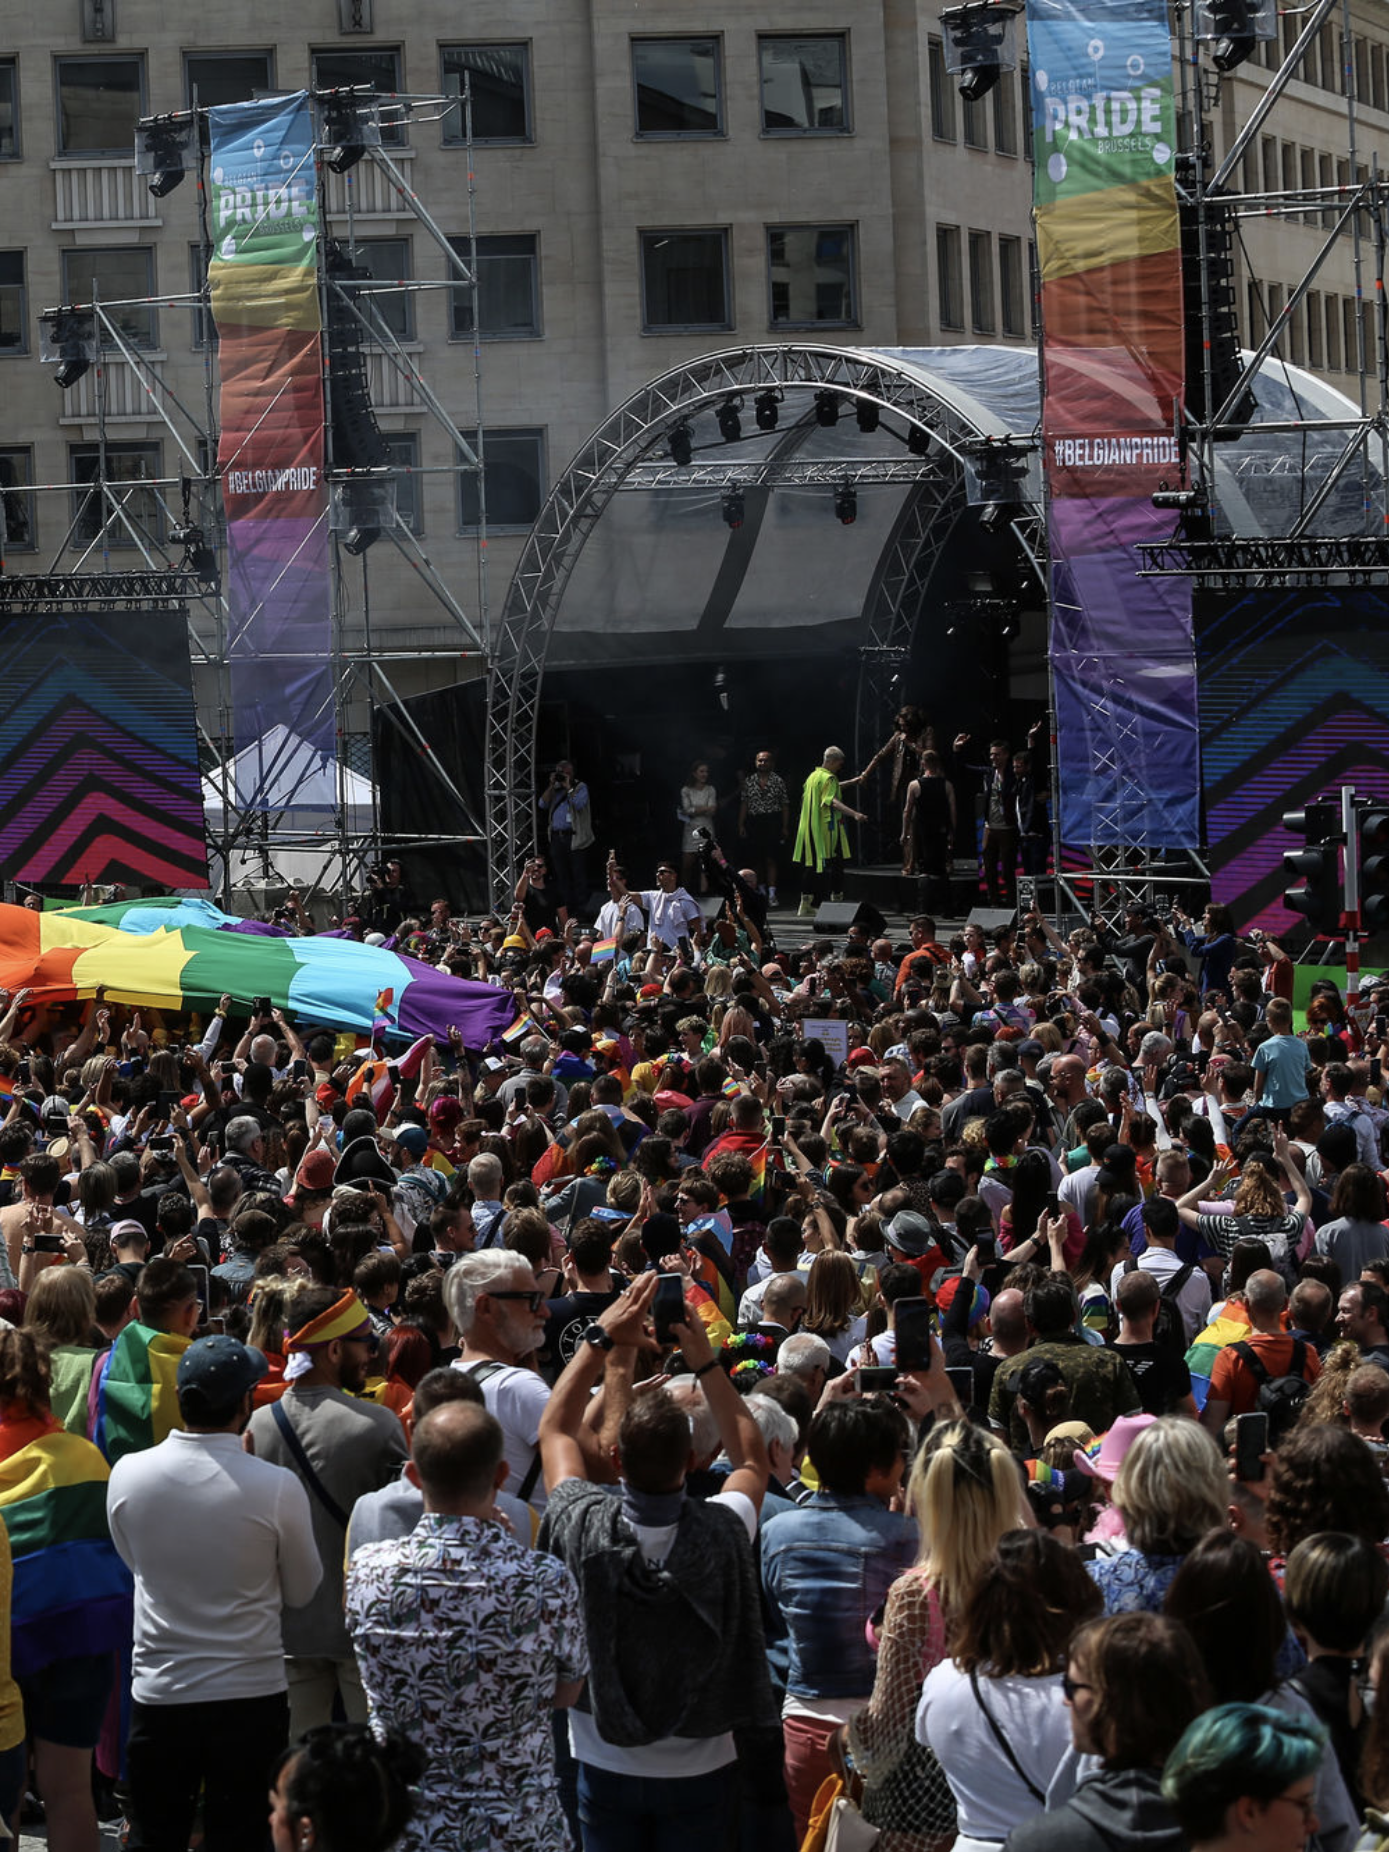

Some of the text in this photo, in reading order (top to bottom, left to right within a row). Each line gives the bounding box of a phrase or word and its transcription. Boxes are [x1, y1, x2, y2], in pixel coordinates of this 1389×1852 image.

[1051, 78, 1096, 95] BELGIAN
[1045, 88, 1161, 142] PRIDE
[1097, 137, 1152, 154] BRUSSELS
[220, 178, 308, 228] PRIDE
[259, 220, 302, 234] BRUSSELS
[1054, 437, 1179, 466] #BELGIANPRIDE
[228, 467, 317, 494] #BELGIANPRIDE
